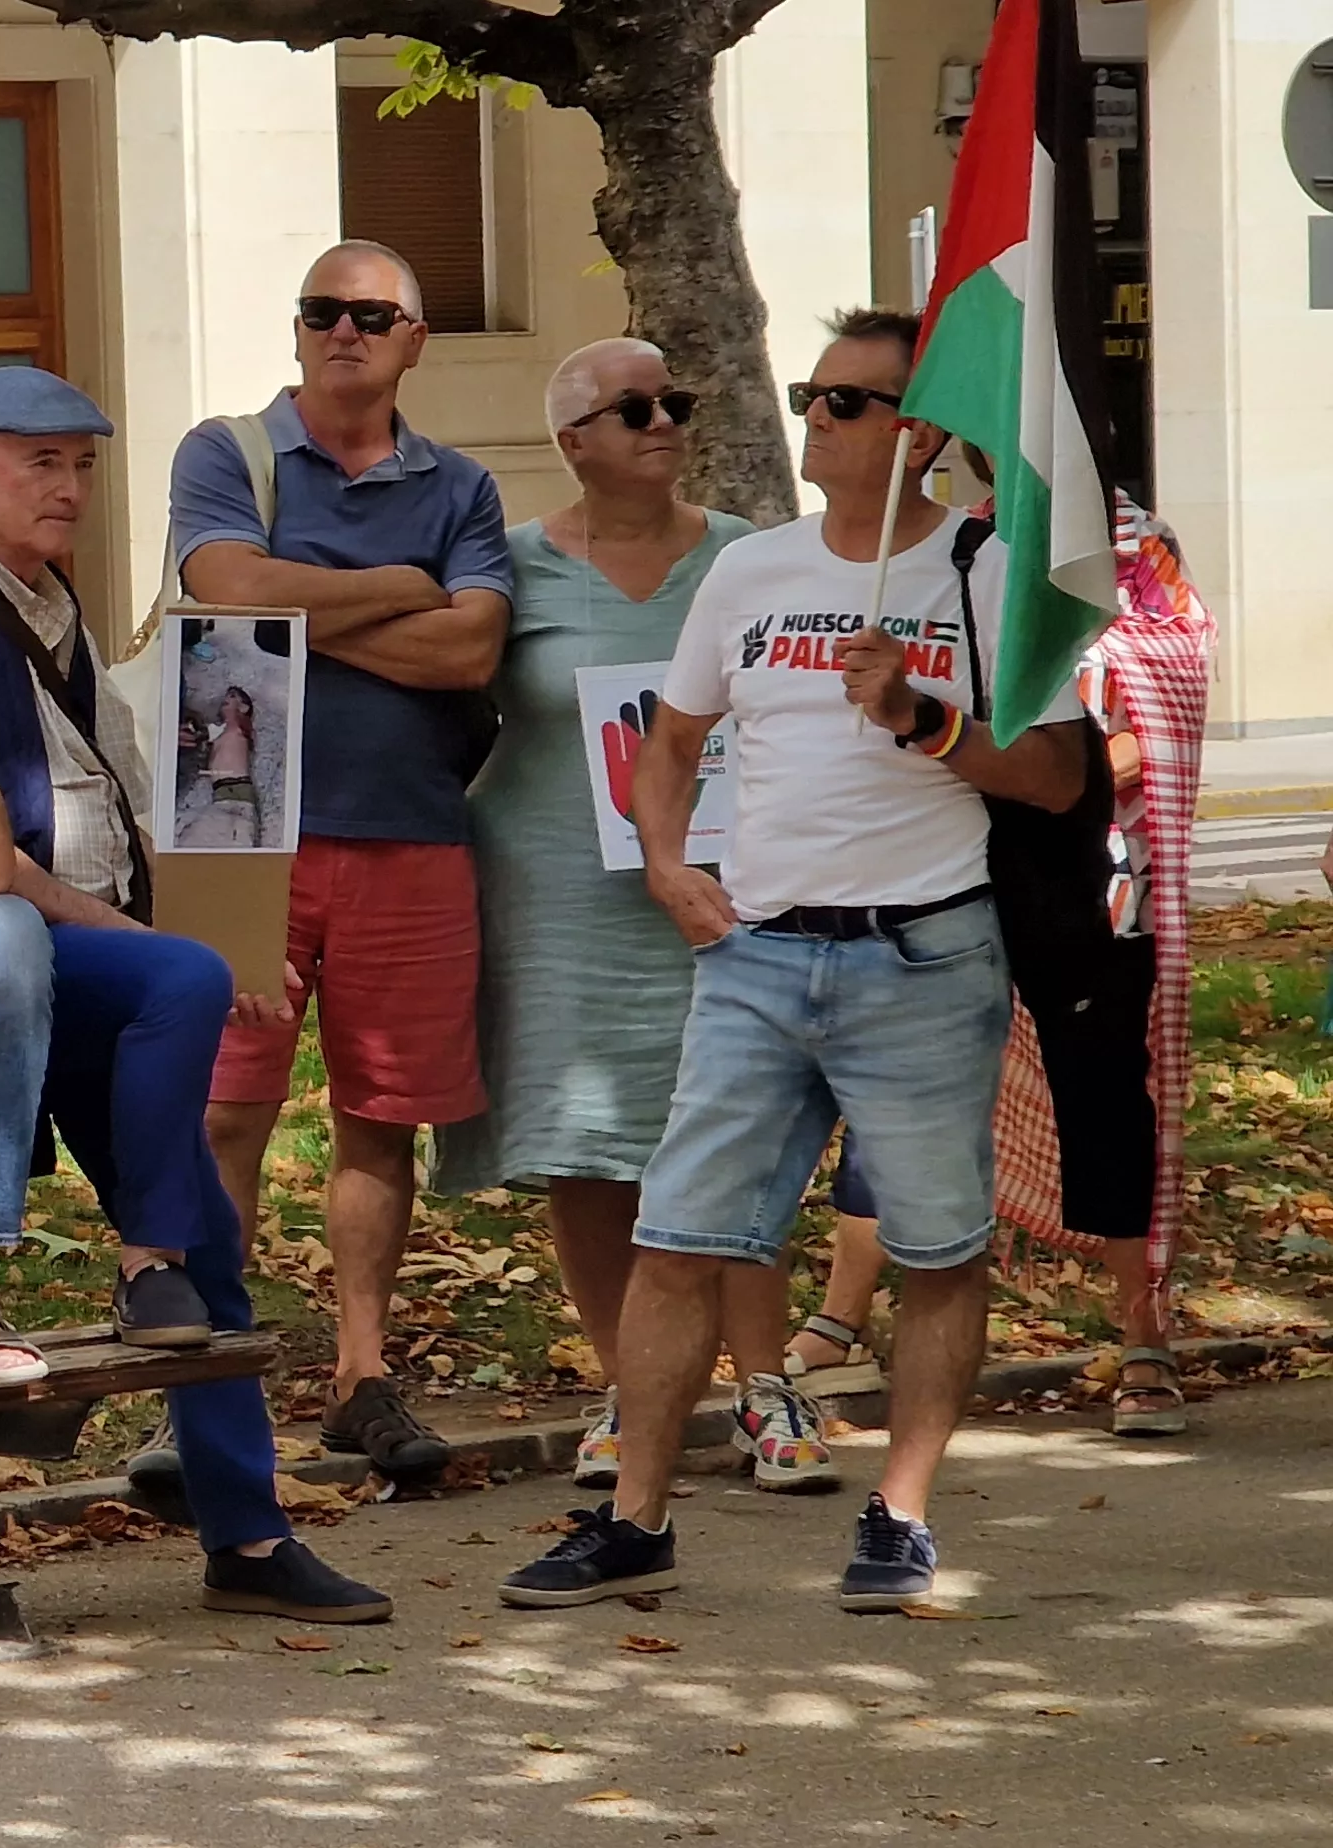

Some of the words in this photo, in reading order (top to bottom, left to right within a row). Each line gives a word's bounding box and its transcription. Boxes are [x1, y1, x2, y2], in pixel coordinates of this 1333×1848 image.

[781, 612, 865, 634] HUESCA
[879, 615, 921, 637] CON
[767, 635, 953, 681] PALENA
